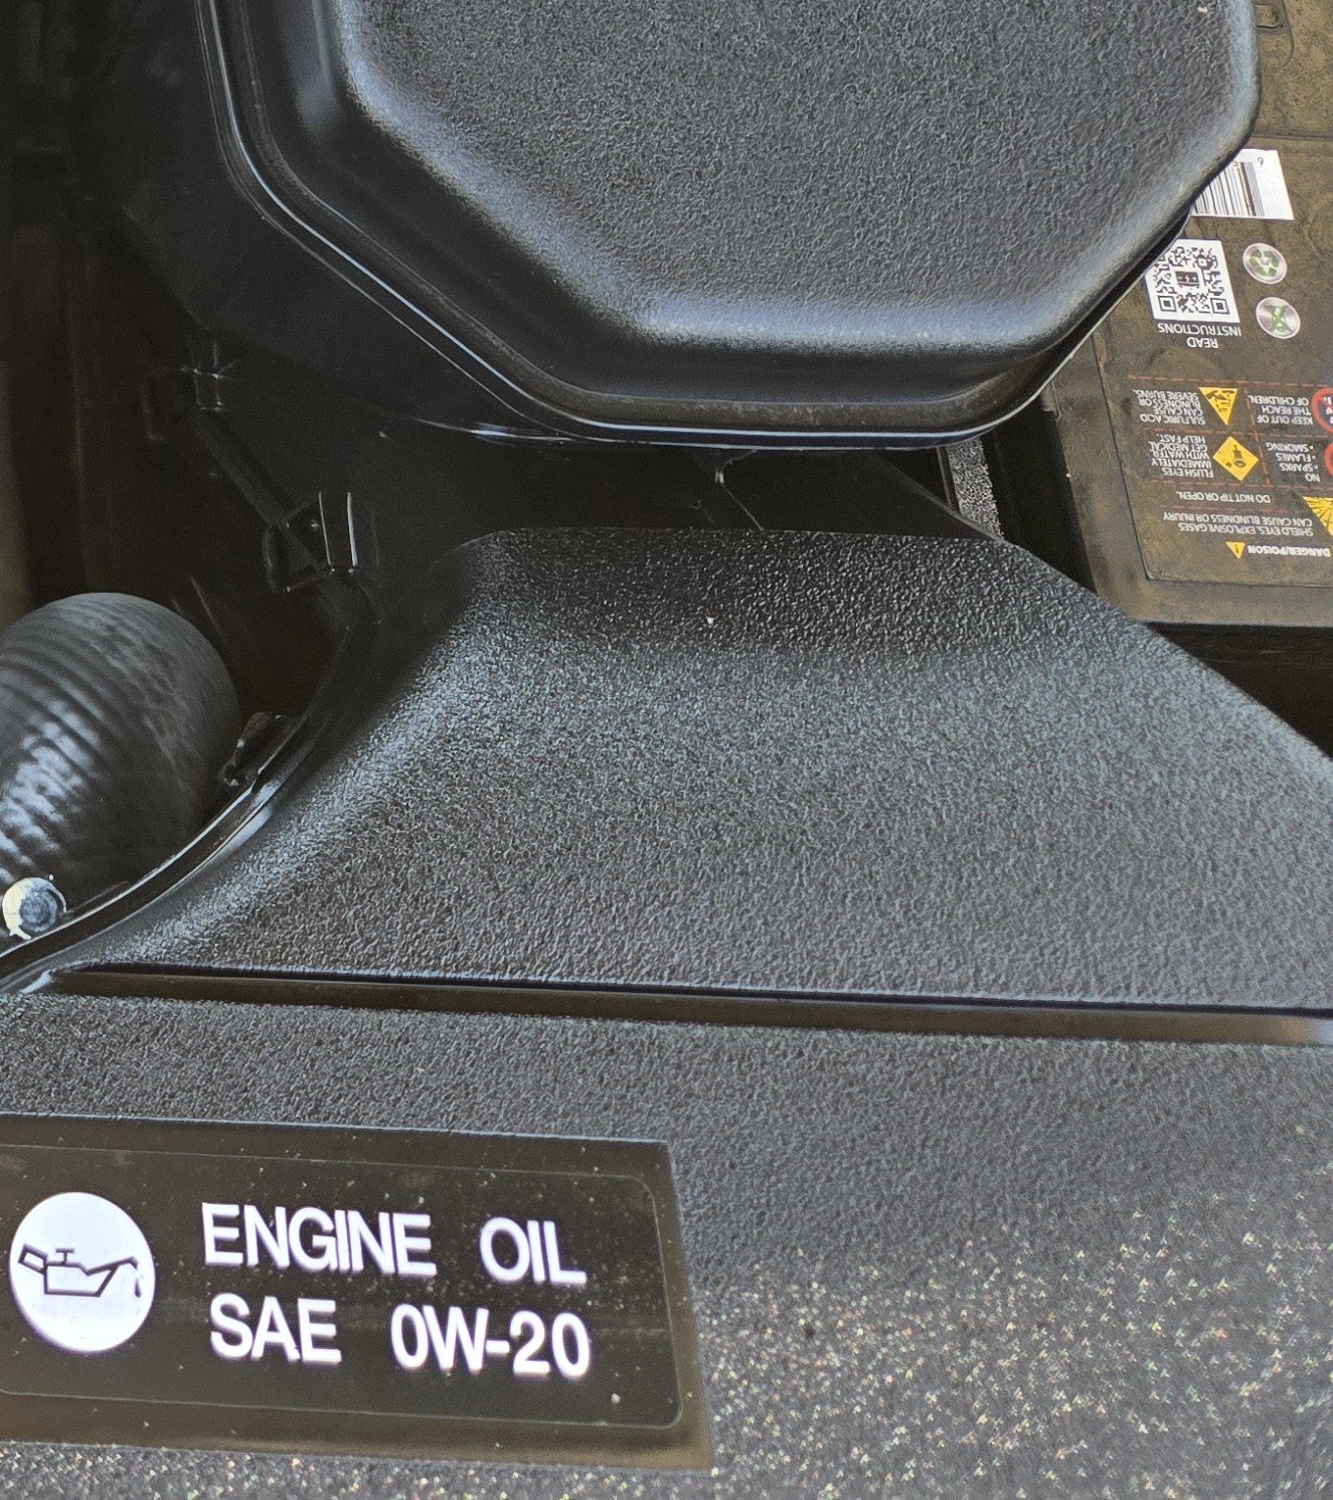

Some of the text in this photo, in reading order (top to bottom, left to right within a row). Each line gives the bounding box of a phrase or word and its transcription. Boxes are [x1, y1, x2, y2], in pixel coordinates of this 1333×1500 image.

[1158, 323, 1242, 337] INSTRUCTIONS
[1186, 337, 1219, 349] READ
[1296, 397, 1309, 406] OF
[1261, 405, 1312, 415] THE REACH
[1256, 415, 1313, 425] KEEP OUT OF
[1182, 435, 1205, 444] HELP
[1148, 441, 1208, 452] GET MEDICAL
[1265, 442, 1309, 452] SMOKING
[1185, 451, 1210, 460] WITH
[1275, 453, 1312, 462] FLAMES
[1151, 458, 1212, 469] IMMEDIATELY
[1279, 463, 1313, 472] SPARKS
[1161, 467, 1214, 478] FLUSH EYES
[1305, 473, 1321, 482] NO
[1205, 492, 1218, 501] OR
[1220, 493, 1234, 502] TIP
[1235, 494, 1254, 502] NOT
[1255, 494, 1271, 503] DO
[1195, 514, 1209, 522] OR
[1210, 514, 1260, 524] BLINDNESS
[1261, 516, 1292, 525] CAUSE
[1292, 518, 1312, 526] CAN
[1178, 522, 1207, 532] GASES
[1207, 524, 1256, 534] EXPLOSIVE
[1281, 527, 1313, 537] SHIELD
[201, 1202, 588, 1285] ENGINE OIL
[209, 1292, 592, 1378] SAE 0W-20
